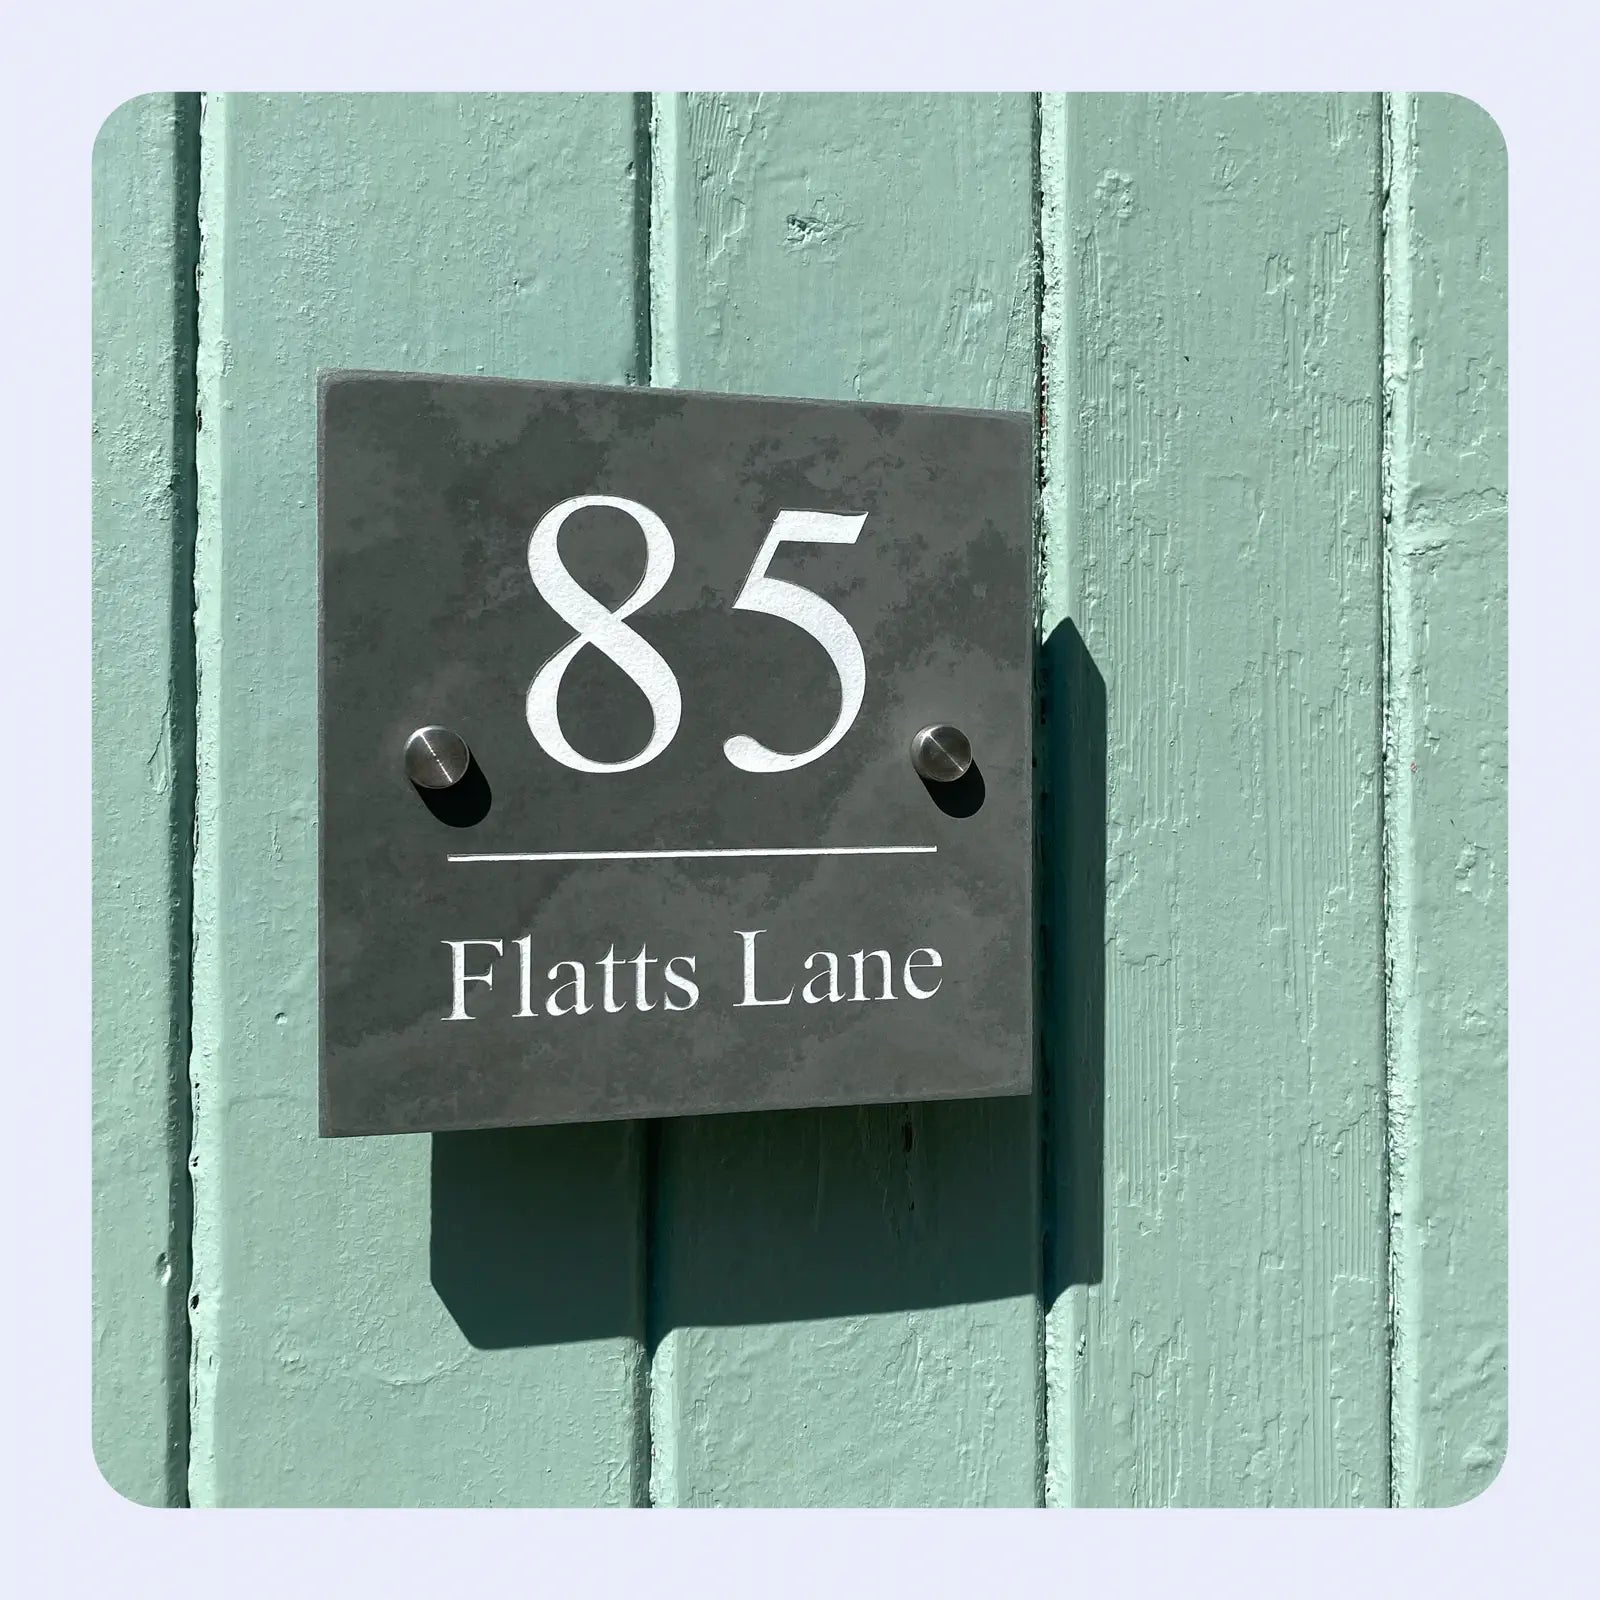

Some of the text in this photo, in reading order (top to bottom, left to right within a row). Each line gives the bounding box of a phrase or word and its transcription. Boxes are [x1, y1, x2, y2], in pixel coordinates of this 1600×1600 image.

[525, 494, 869, 774] 85
[440, 929, 944, 1022] Flatts Lane
